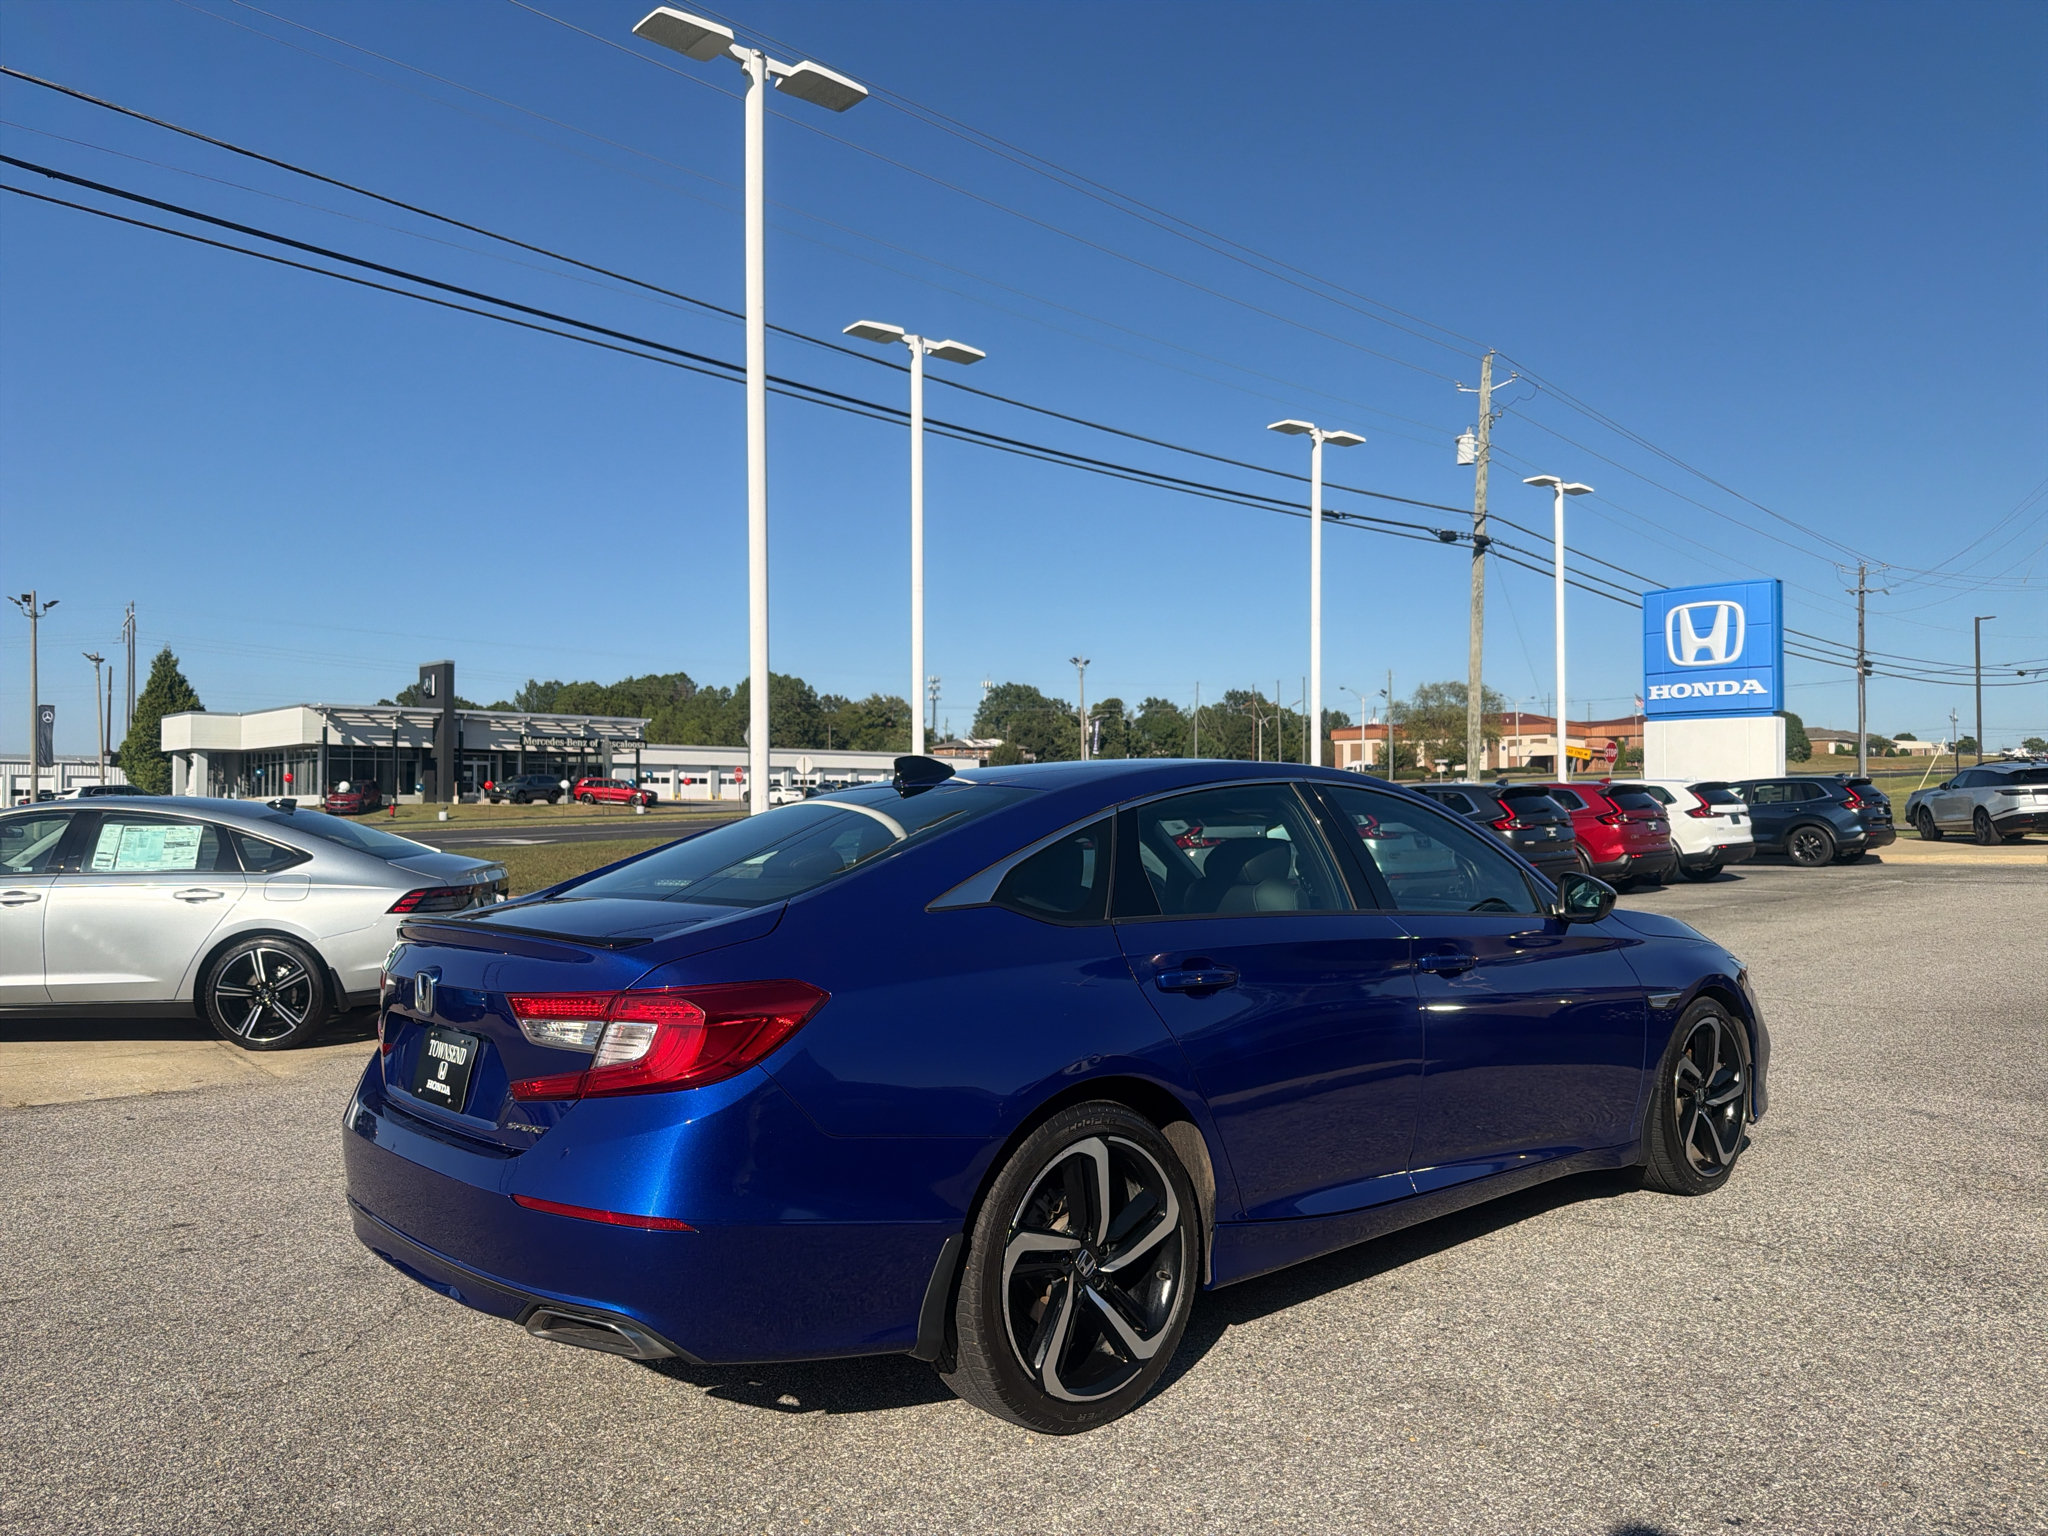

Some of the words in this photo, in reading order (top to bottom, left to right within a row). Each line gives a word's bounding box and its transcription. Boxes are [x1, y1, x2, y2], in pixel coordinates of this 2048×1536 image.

[1647, 679, 1768, 700] HONDA
[523, 736, 588, 748] Mercedes-Benz
[589, 739, 598, 748] of
[1605, 748, 1618, 757] STOP
[428, 1039, 467, 1066] TOWNSEND
[425, 1079, 451, 1096] HONDA
